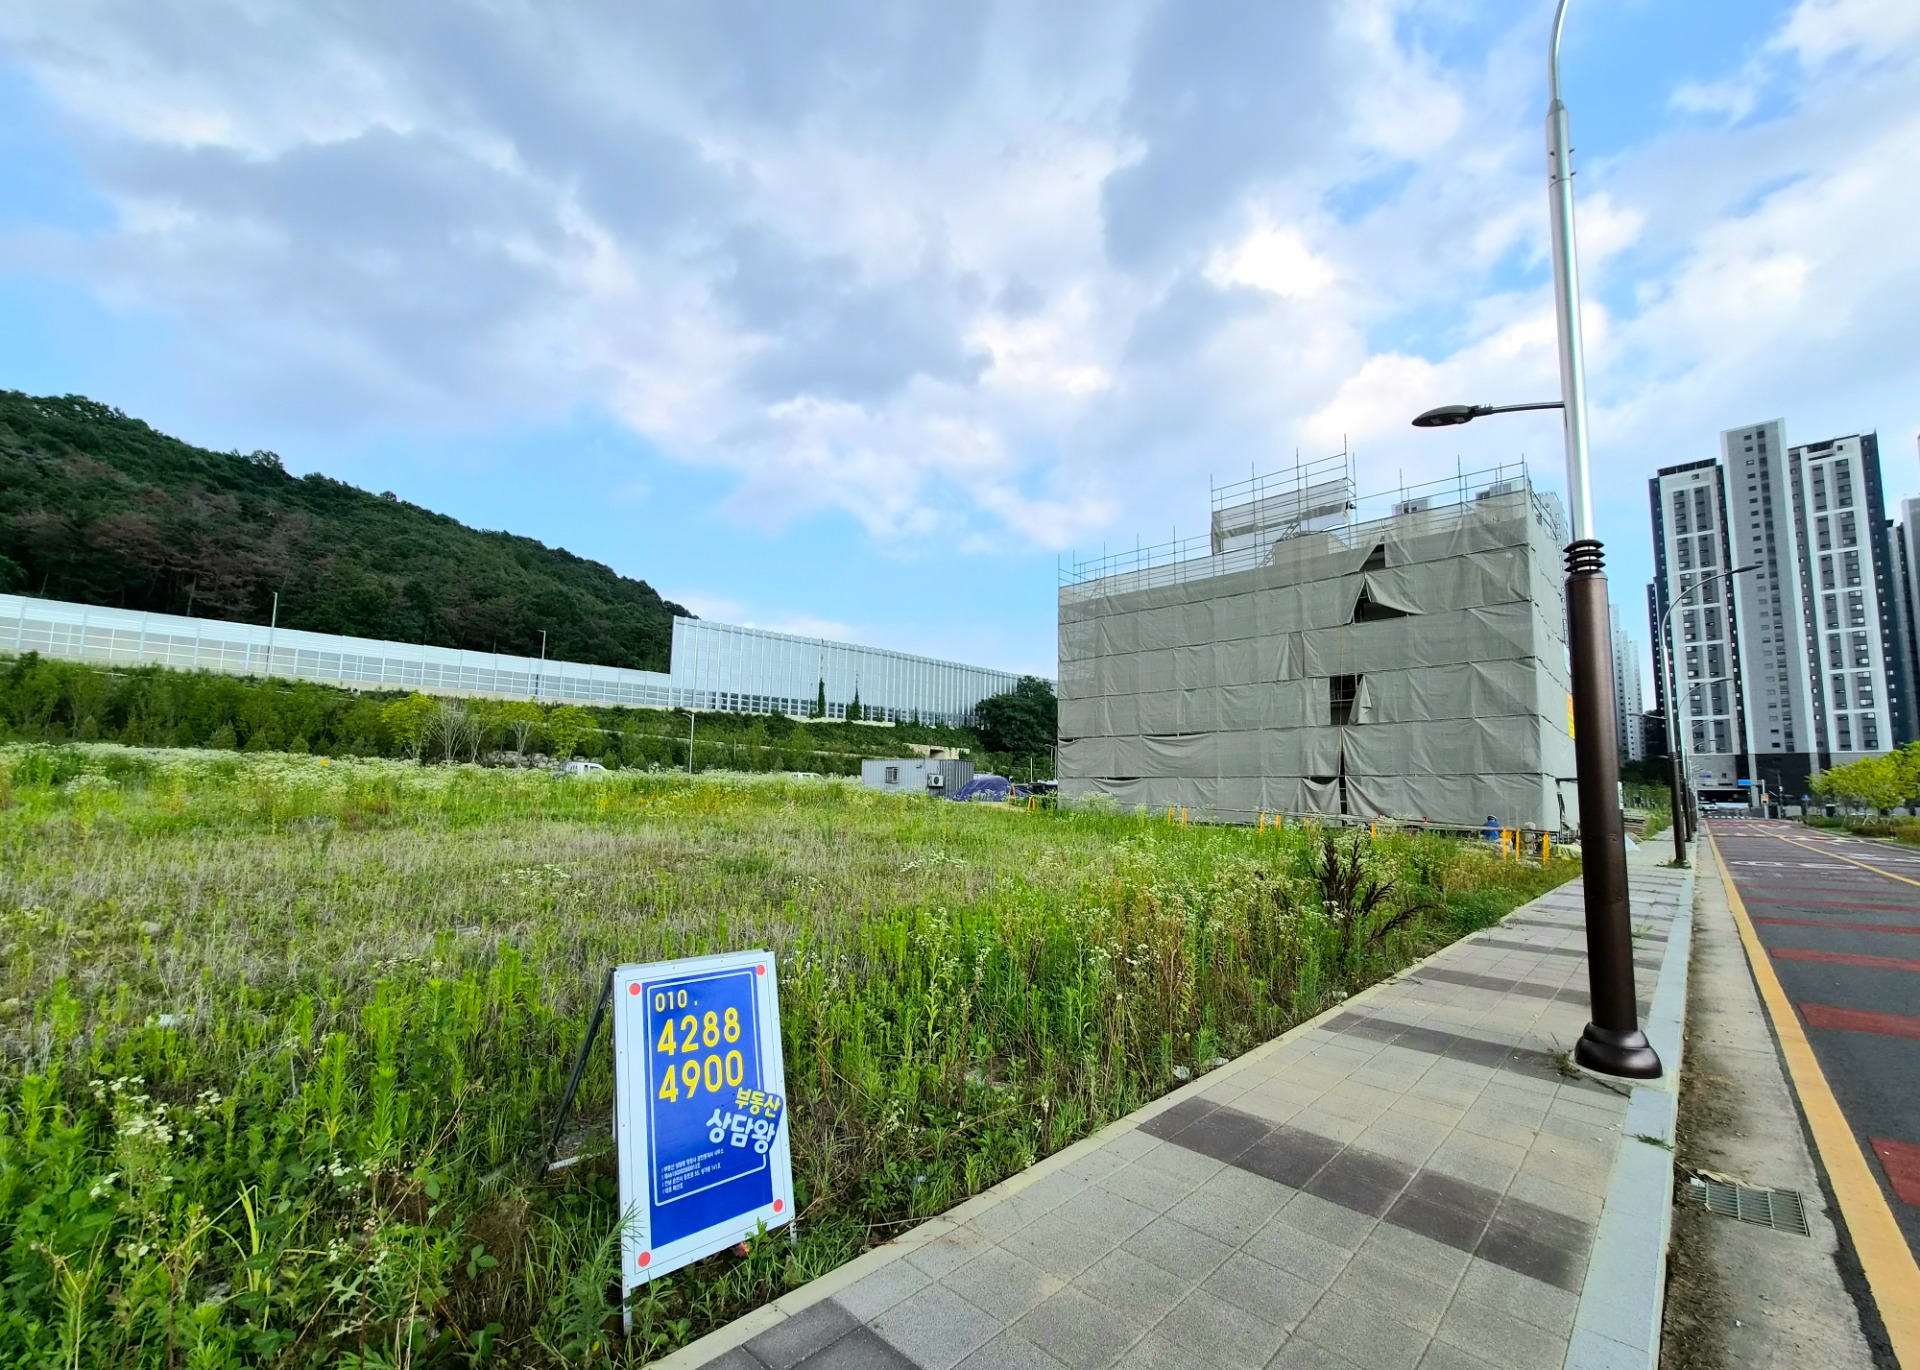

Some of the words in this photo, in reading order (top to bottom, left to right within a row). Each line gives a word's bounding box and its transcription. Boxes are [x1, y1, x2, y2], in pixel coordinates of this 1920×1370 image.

[657, 1007, 741, 1056] 4288
[658, 1049, 744, 1104] 4900
[735, 1086, 781, 1119] 부동산
[706, 1108, 776, 1154] 상담왕
